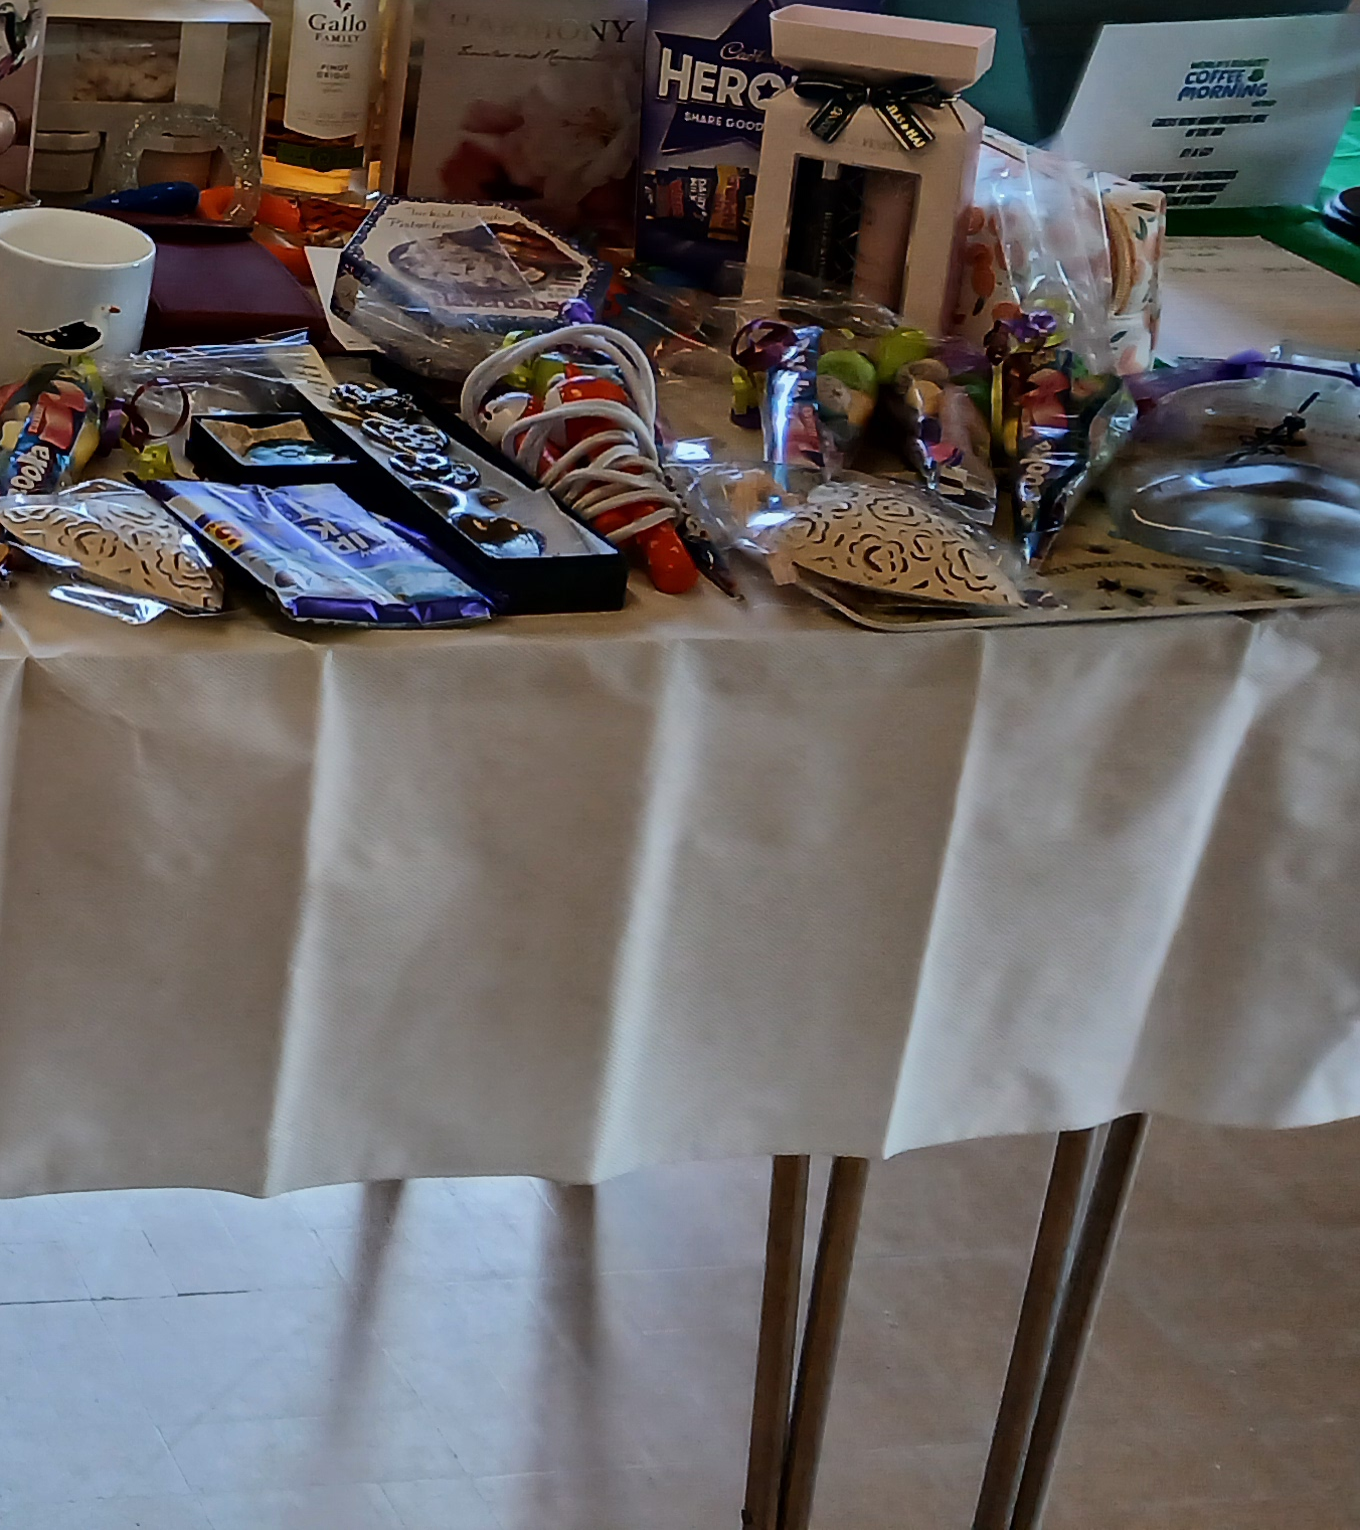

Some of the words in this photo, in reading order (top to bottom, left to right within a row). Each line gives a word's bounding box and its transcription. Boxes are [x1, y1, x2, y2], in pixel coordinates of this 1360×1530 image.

[308, 13, 367, 32] Gallo
[315, 32, 360, 43] FAMILY
[1184, 69, 1246, 85] COFFEE
[1177, 83, 1268, 102] MORNING
[684, 110, 722, 128] SHARE
